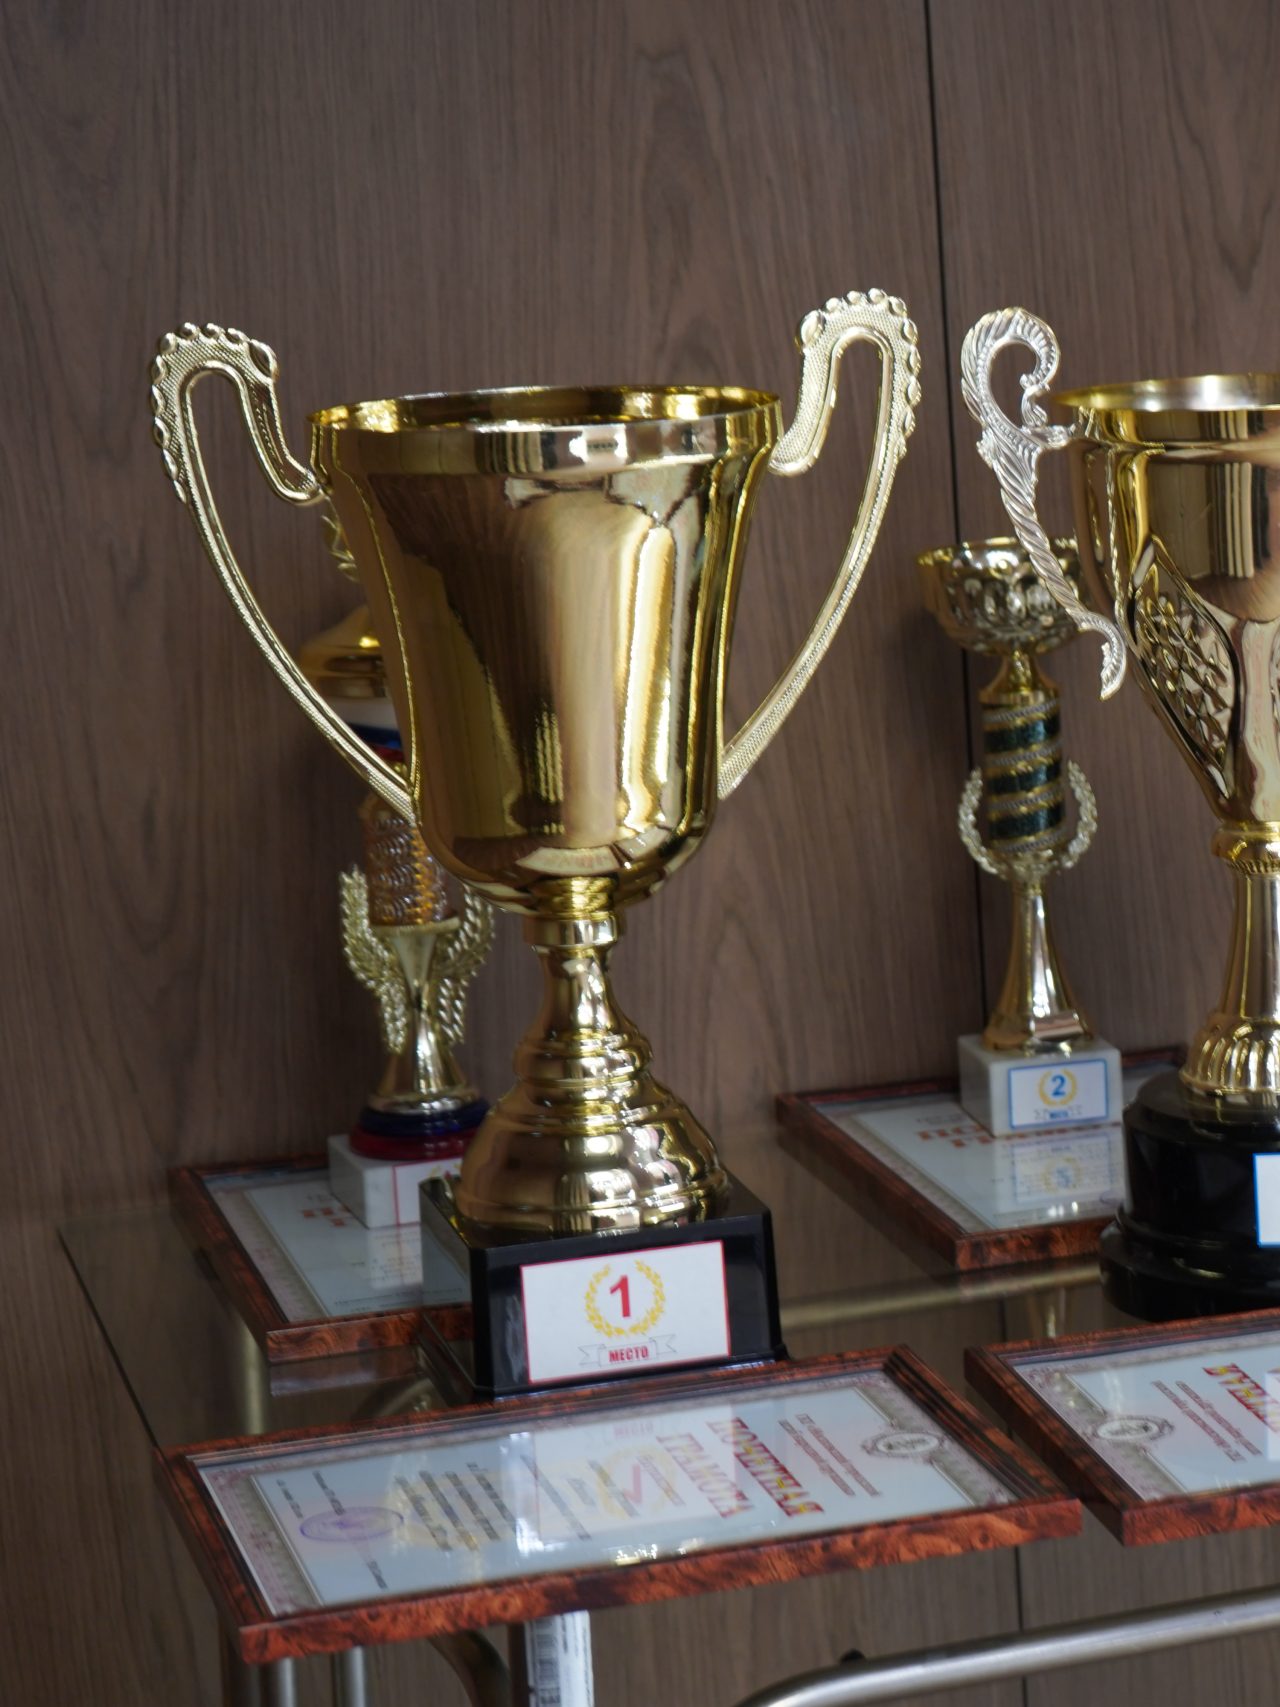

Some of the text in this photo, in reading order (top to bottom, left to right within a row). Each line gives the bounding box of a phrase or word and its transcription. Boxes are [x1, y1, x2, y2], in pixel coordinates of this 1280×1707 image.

[1050, 1074, 1067, 1097] 2
[609, 1274, 631, 1319] 1
[609, 1346, 649, 1363] МЕСТО
